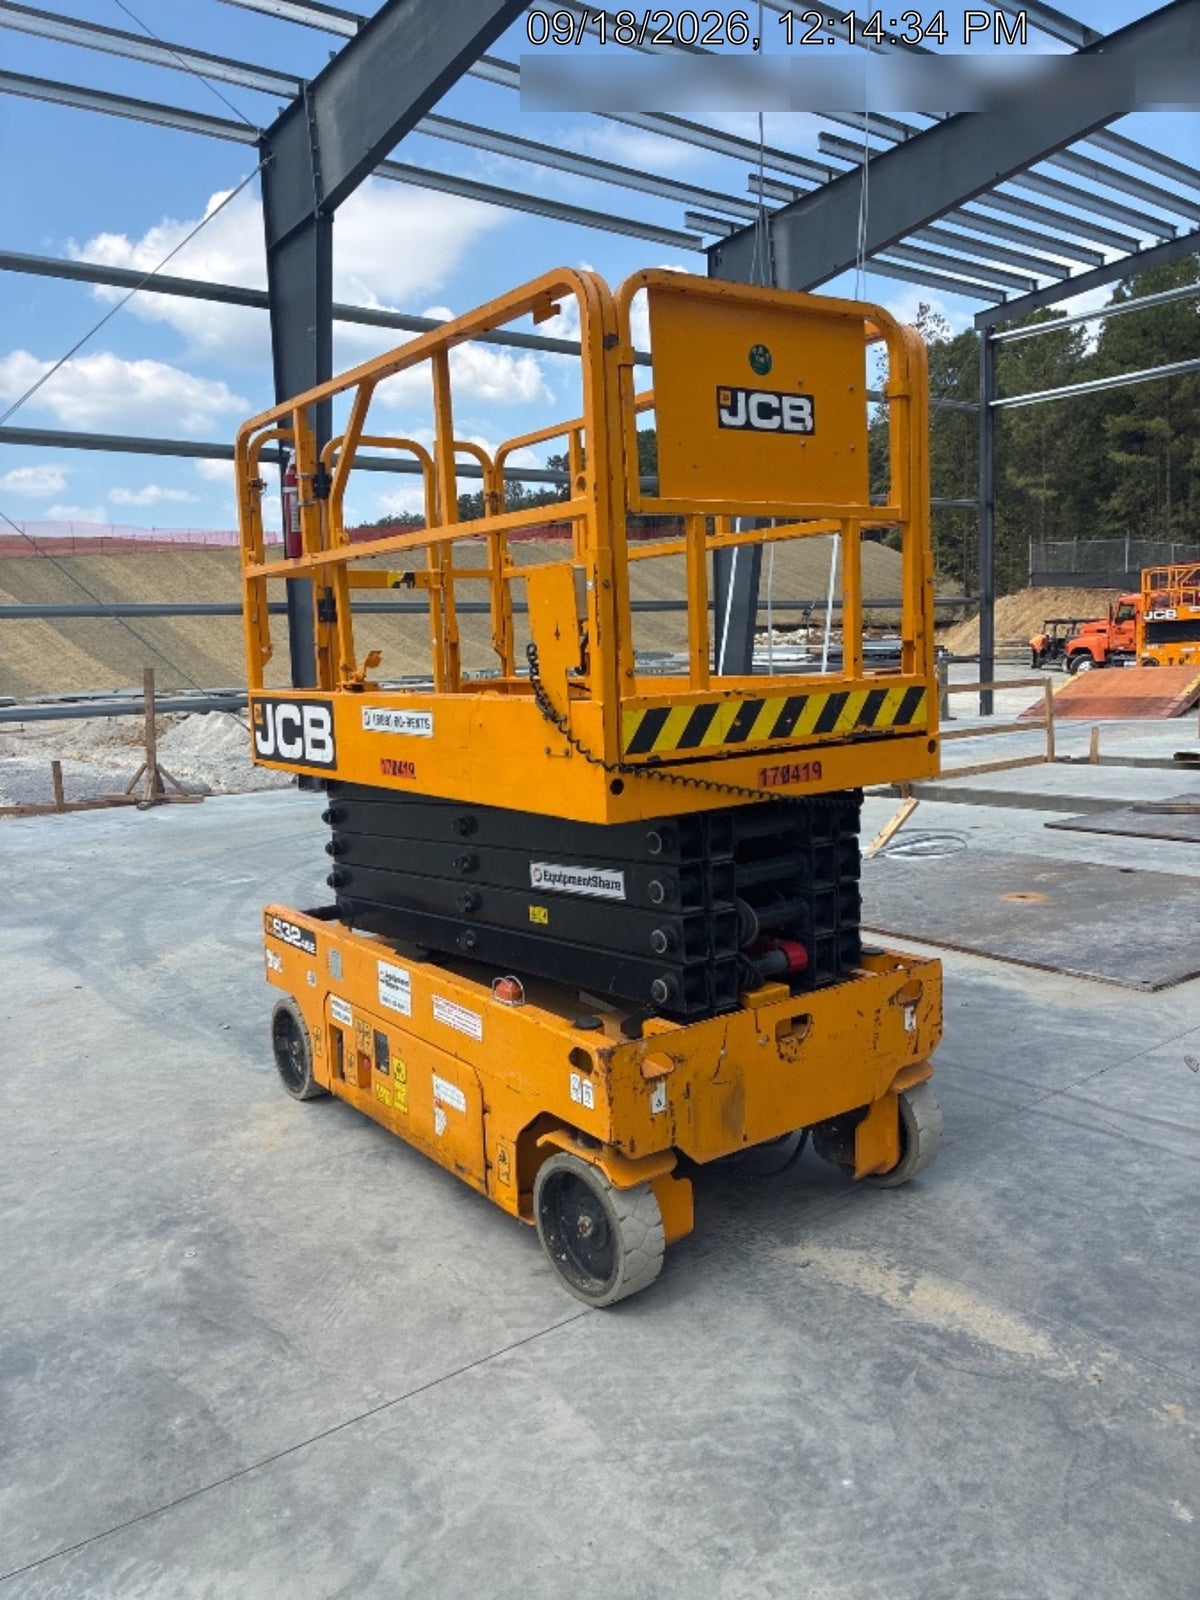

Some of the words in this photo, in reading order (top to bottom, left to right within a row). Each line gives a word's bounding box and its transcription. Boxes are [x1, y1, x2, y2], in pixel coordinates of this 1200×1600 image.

[720, 391, 814, 431] JCB
[1143, 609, 1177, 621] JCB
[255, 703, 335, 764] JCB
[760, 761, 823, 787] 170419
[543, 870, 621, 891] EquipmentShare
